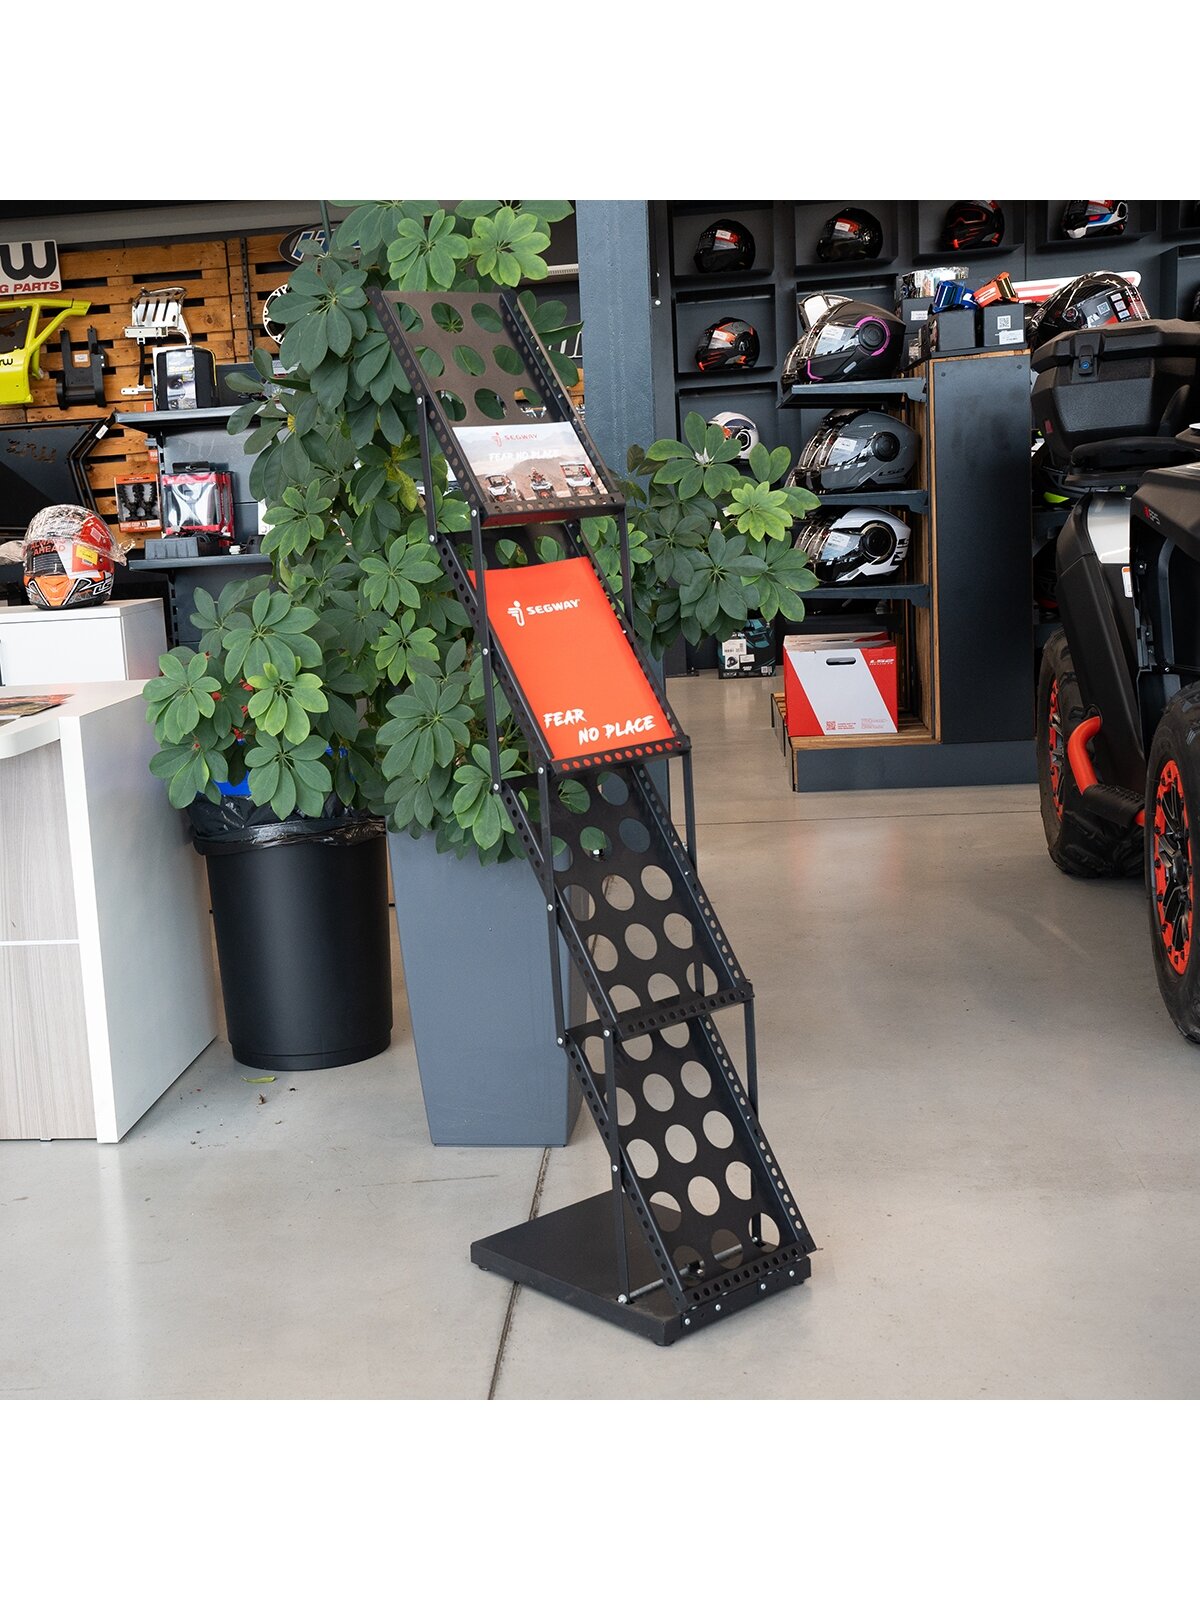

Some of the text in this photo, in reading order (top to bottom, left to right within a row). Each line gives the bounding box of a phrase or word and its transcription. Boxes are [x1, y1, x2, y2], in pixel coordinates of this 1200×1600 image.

[13, 281, 59, 293] PARTS
[504, 433, 538, 441] SEGWAY
[488, 452, 514, 461] FEAR
[33, 545, 66, 556] AHEAD
[526, 599, 580, 615] SEGWAY
[543, 708, 587, 728] FEAR
[578, 715, 656, 745] NO PLACE
